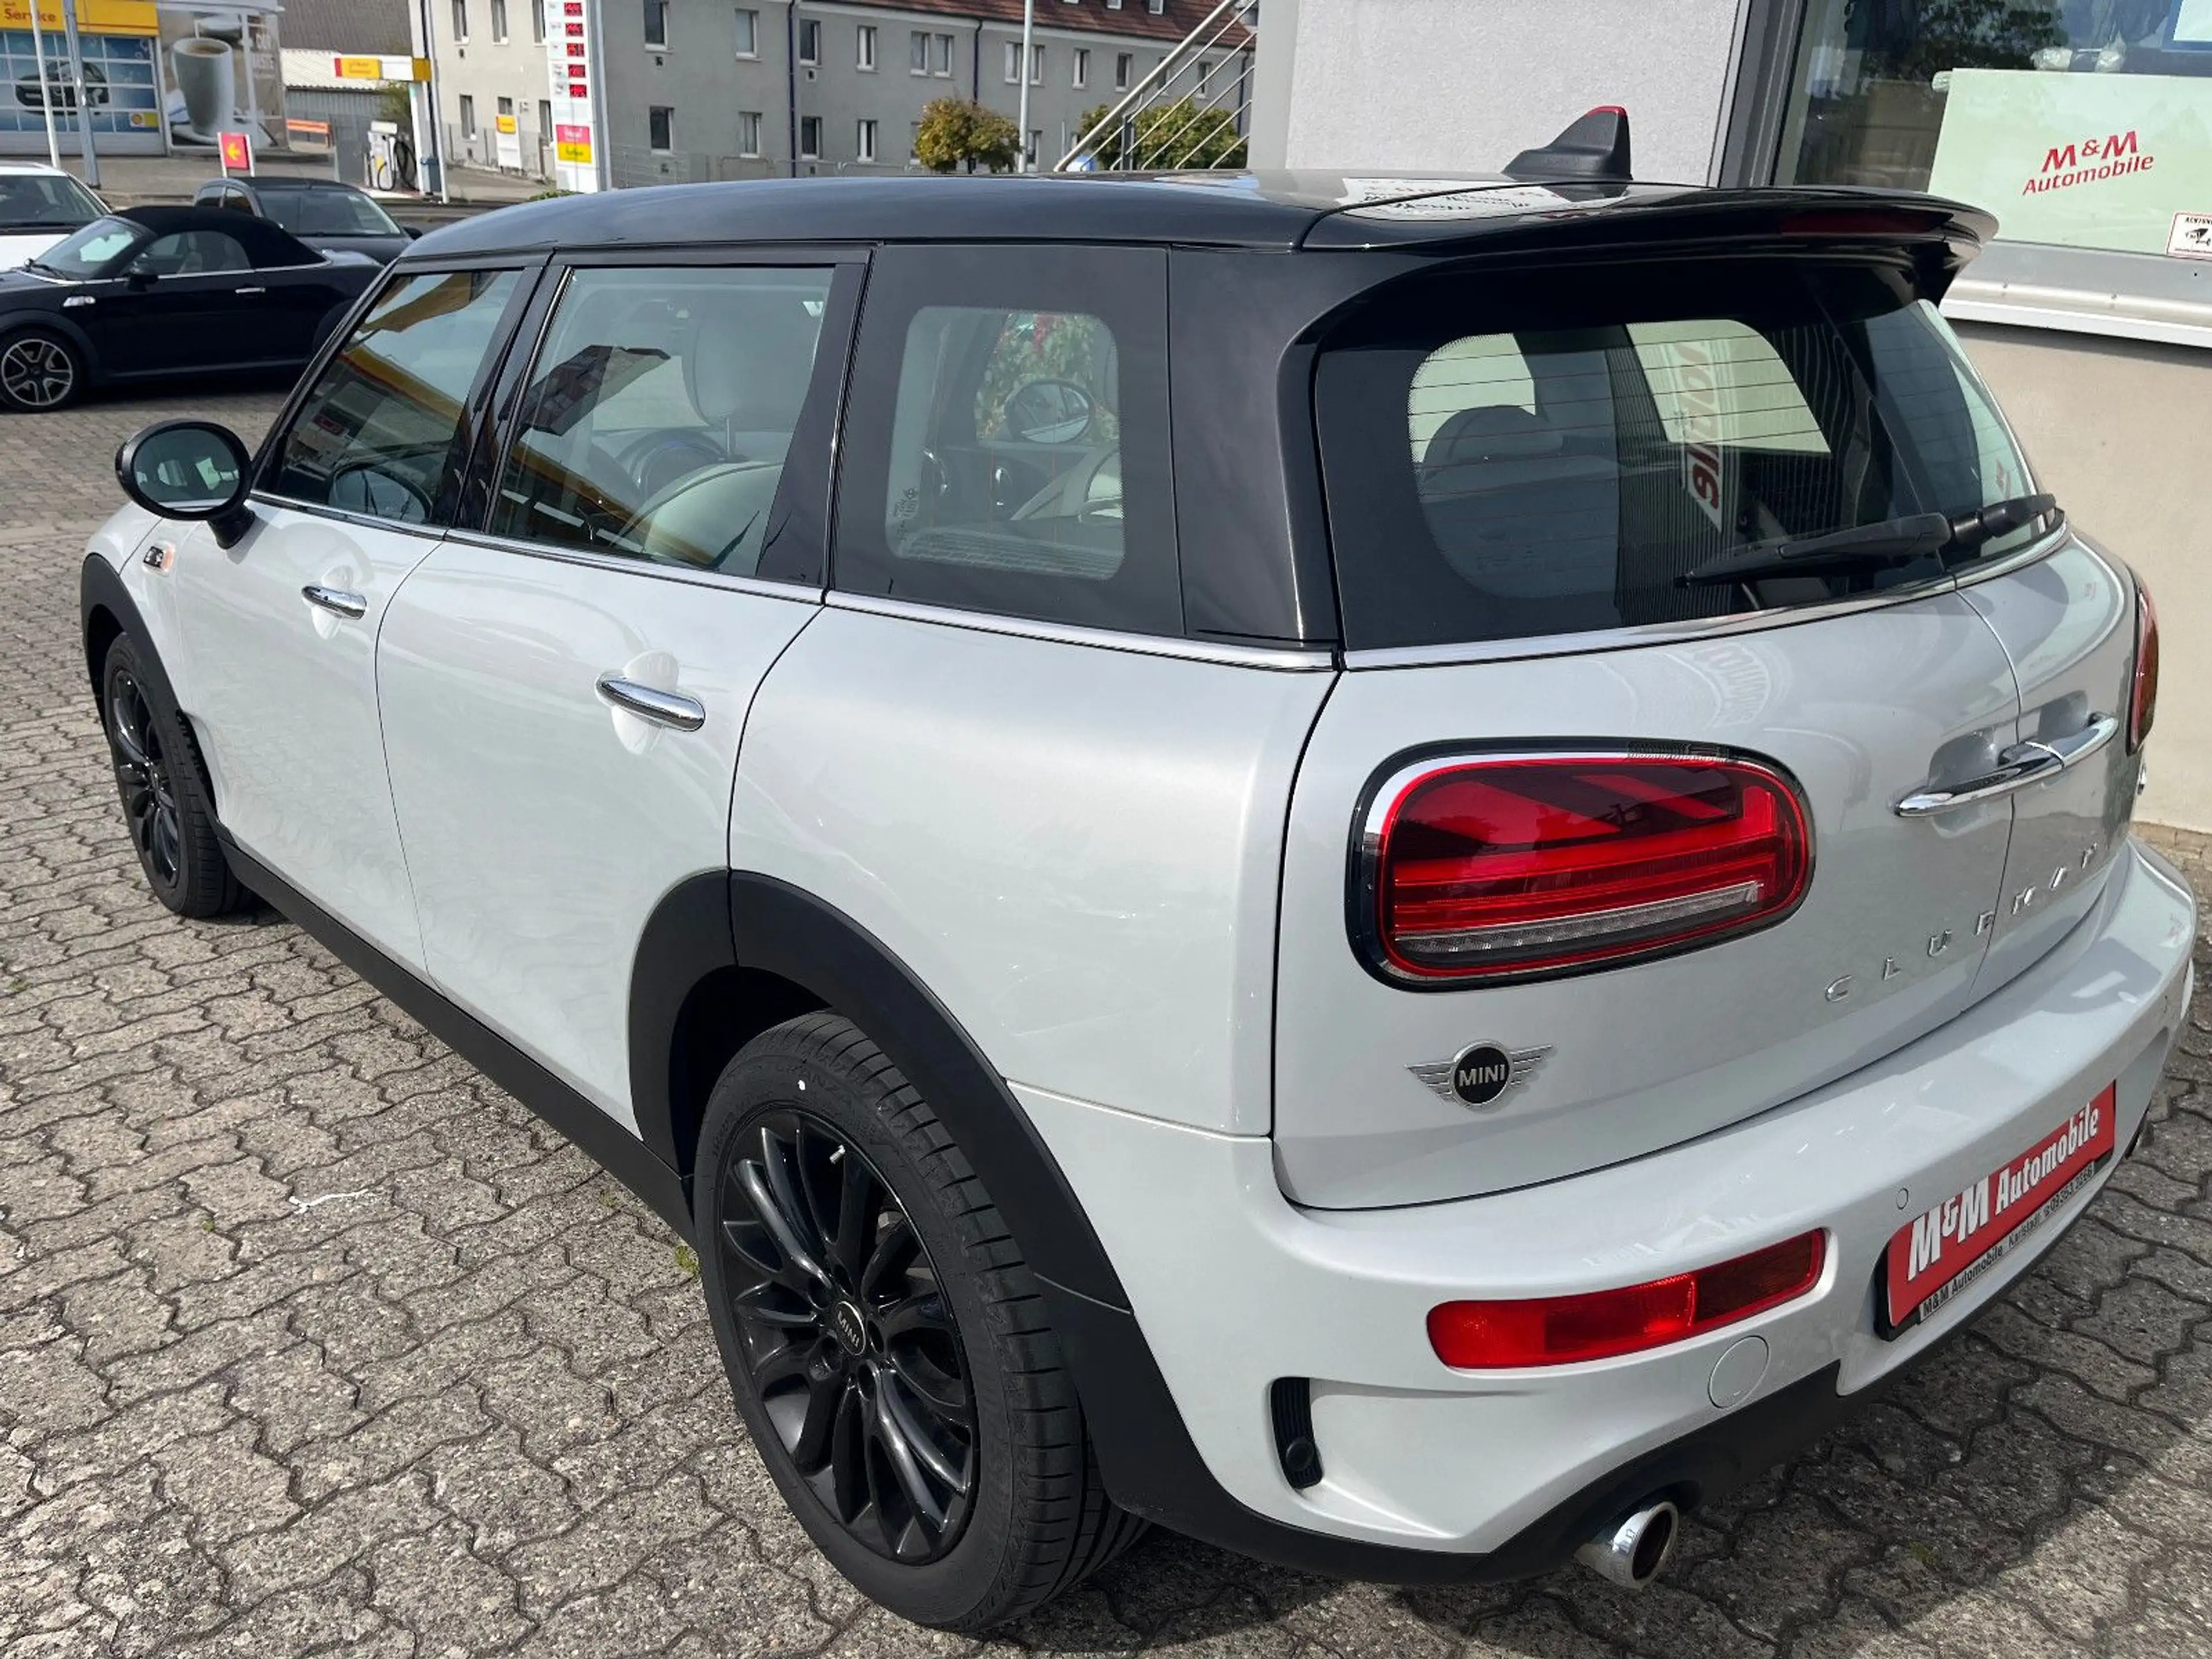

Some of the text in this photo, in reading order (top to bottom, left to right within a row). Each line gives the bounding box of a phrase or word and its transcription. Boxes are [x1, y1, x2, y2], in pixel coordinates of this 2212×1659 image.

[4, 8, 56, 21] Serice
[2041, 130, 2138, 173] M&M
[2022, 156, 2154, 196] Automobile
[1459, 1063, 1505, 1087] MINI
[1907, 1102, 2099, 1281] M&M Automobile
[1923, 1285, 1949, 1317] M&M
[1952, 1245, 2003, 1295] Automobile
[837, 1310, 860, 1349] MINI
